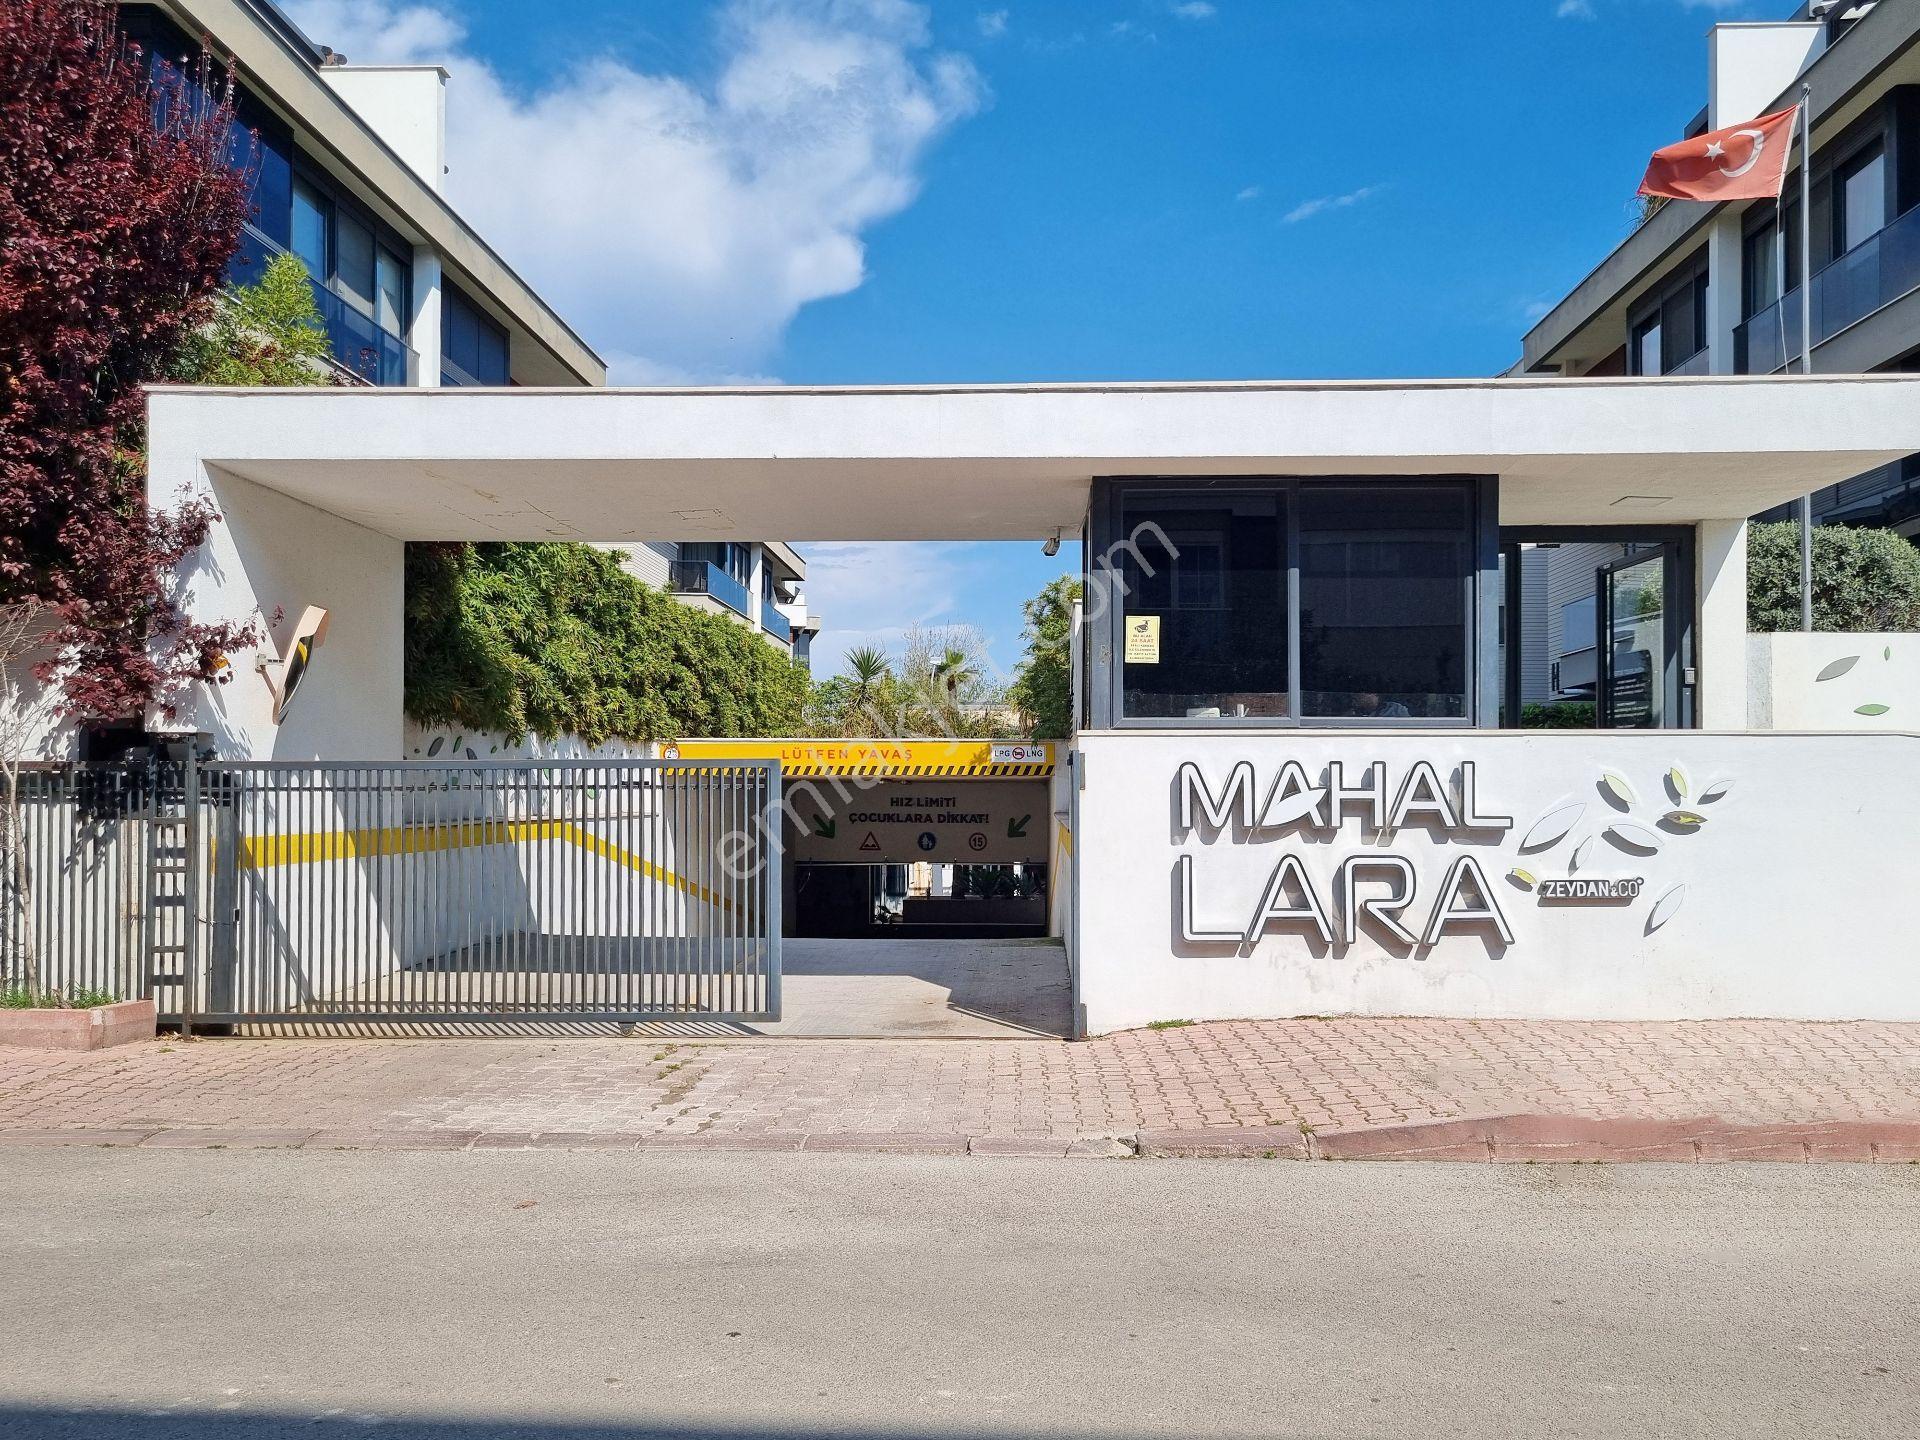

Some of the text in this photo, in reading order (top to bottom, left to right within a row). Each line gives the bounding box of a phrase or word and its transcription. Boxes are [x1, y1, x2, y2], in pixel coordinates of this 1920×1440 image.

[782, 747, 913, 761] LÜTFEN YAVAŞ
[994, 749, 1010, 757] LPG
[1026, 749, 1043, 757] LNG
[1179, 760, 1513, 830] MAHAL
[890, 796, 956, 808] HIZ LİMİTİ
[848, 811, 990, 824] ÇOCUKLARA DİKKAT!
[972, 836, 984, 848] 15
[1180, 854, 1515, 946] LARA
